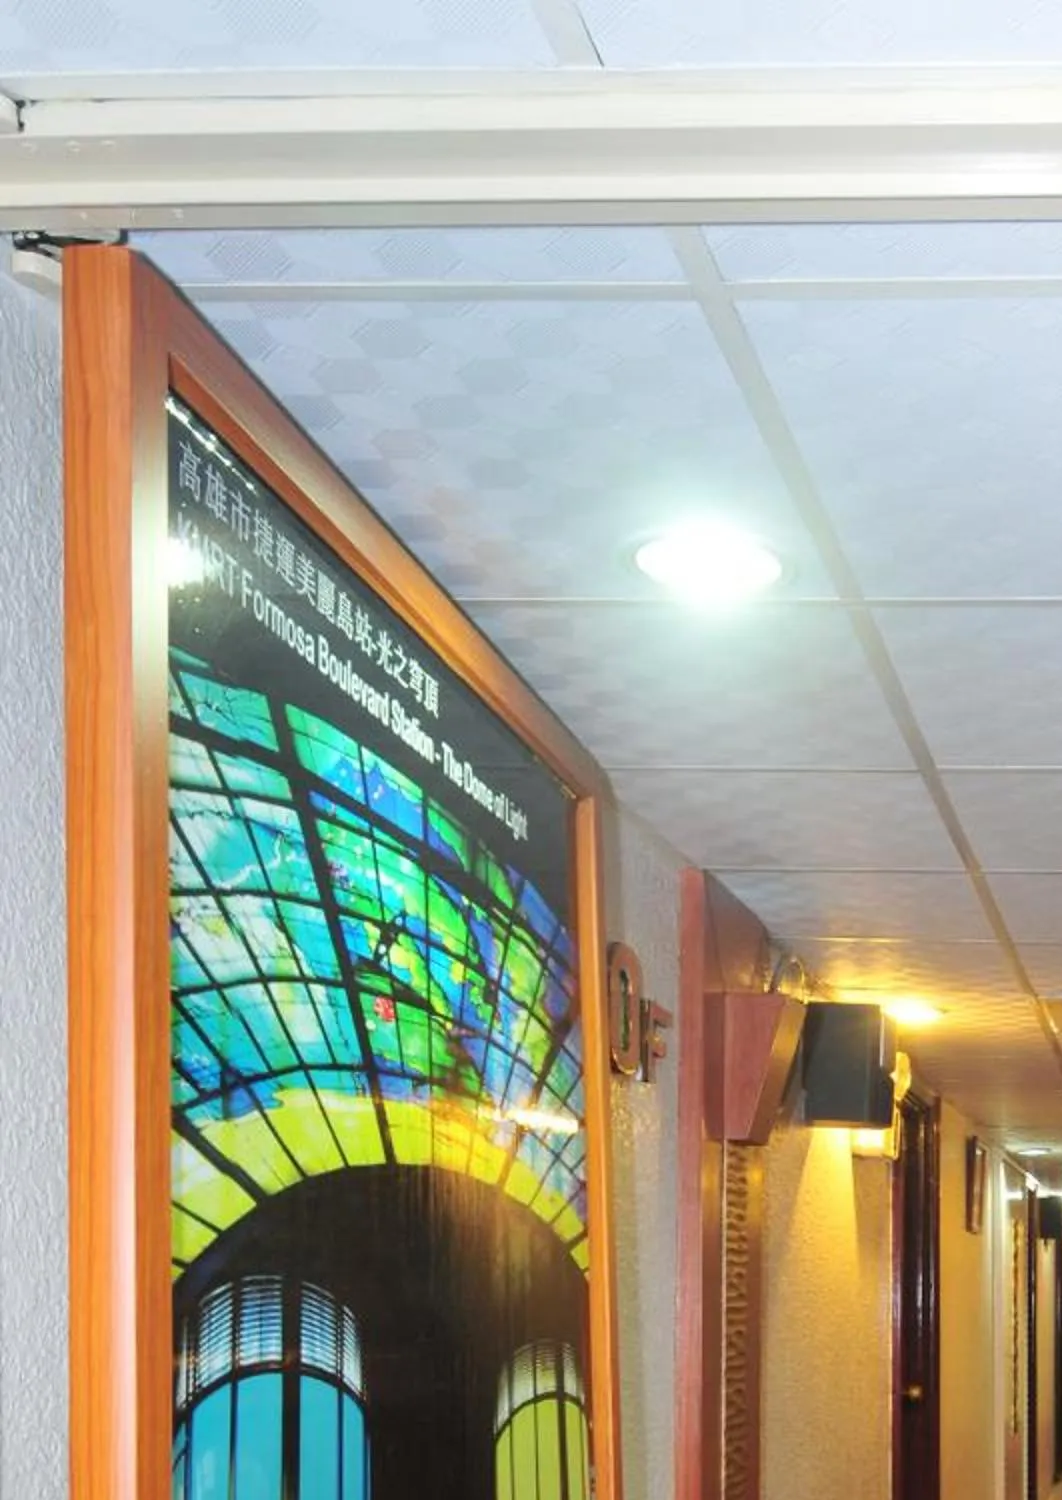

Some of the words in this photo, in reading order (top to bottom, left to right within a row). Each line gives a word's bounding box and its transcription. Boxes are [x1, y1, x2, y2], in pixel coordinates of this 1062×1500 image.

[242, 567, 315, 666] Formosa
[317, 634, 390, 727] Boulevard
[391, 699, 435, 764] Station
[441, 741, 463, 787] The
[463, 761, 493, 813] Dome
[505, 797, 528, 841] Light
